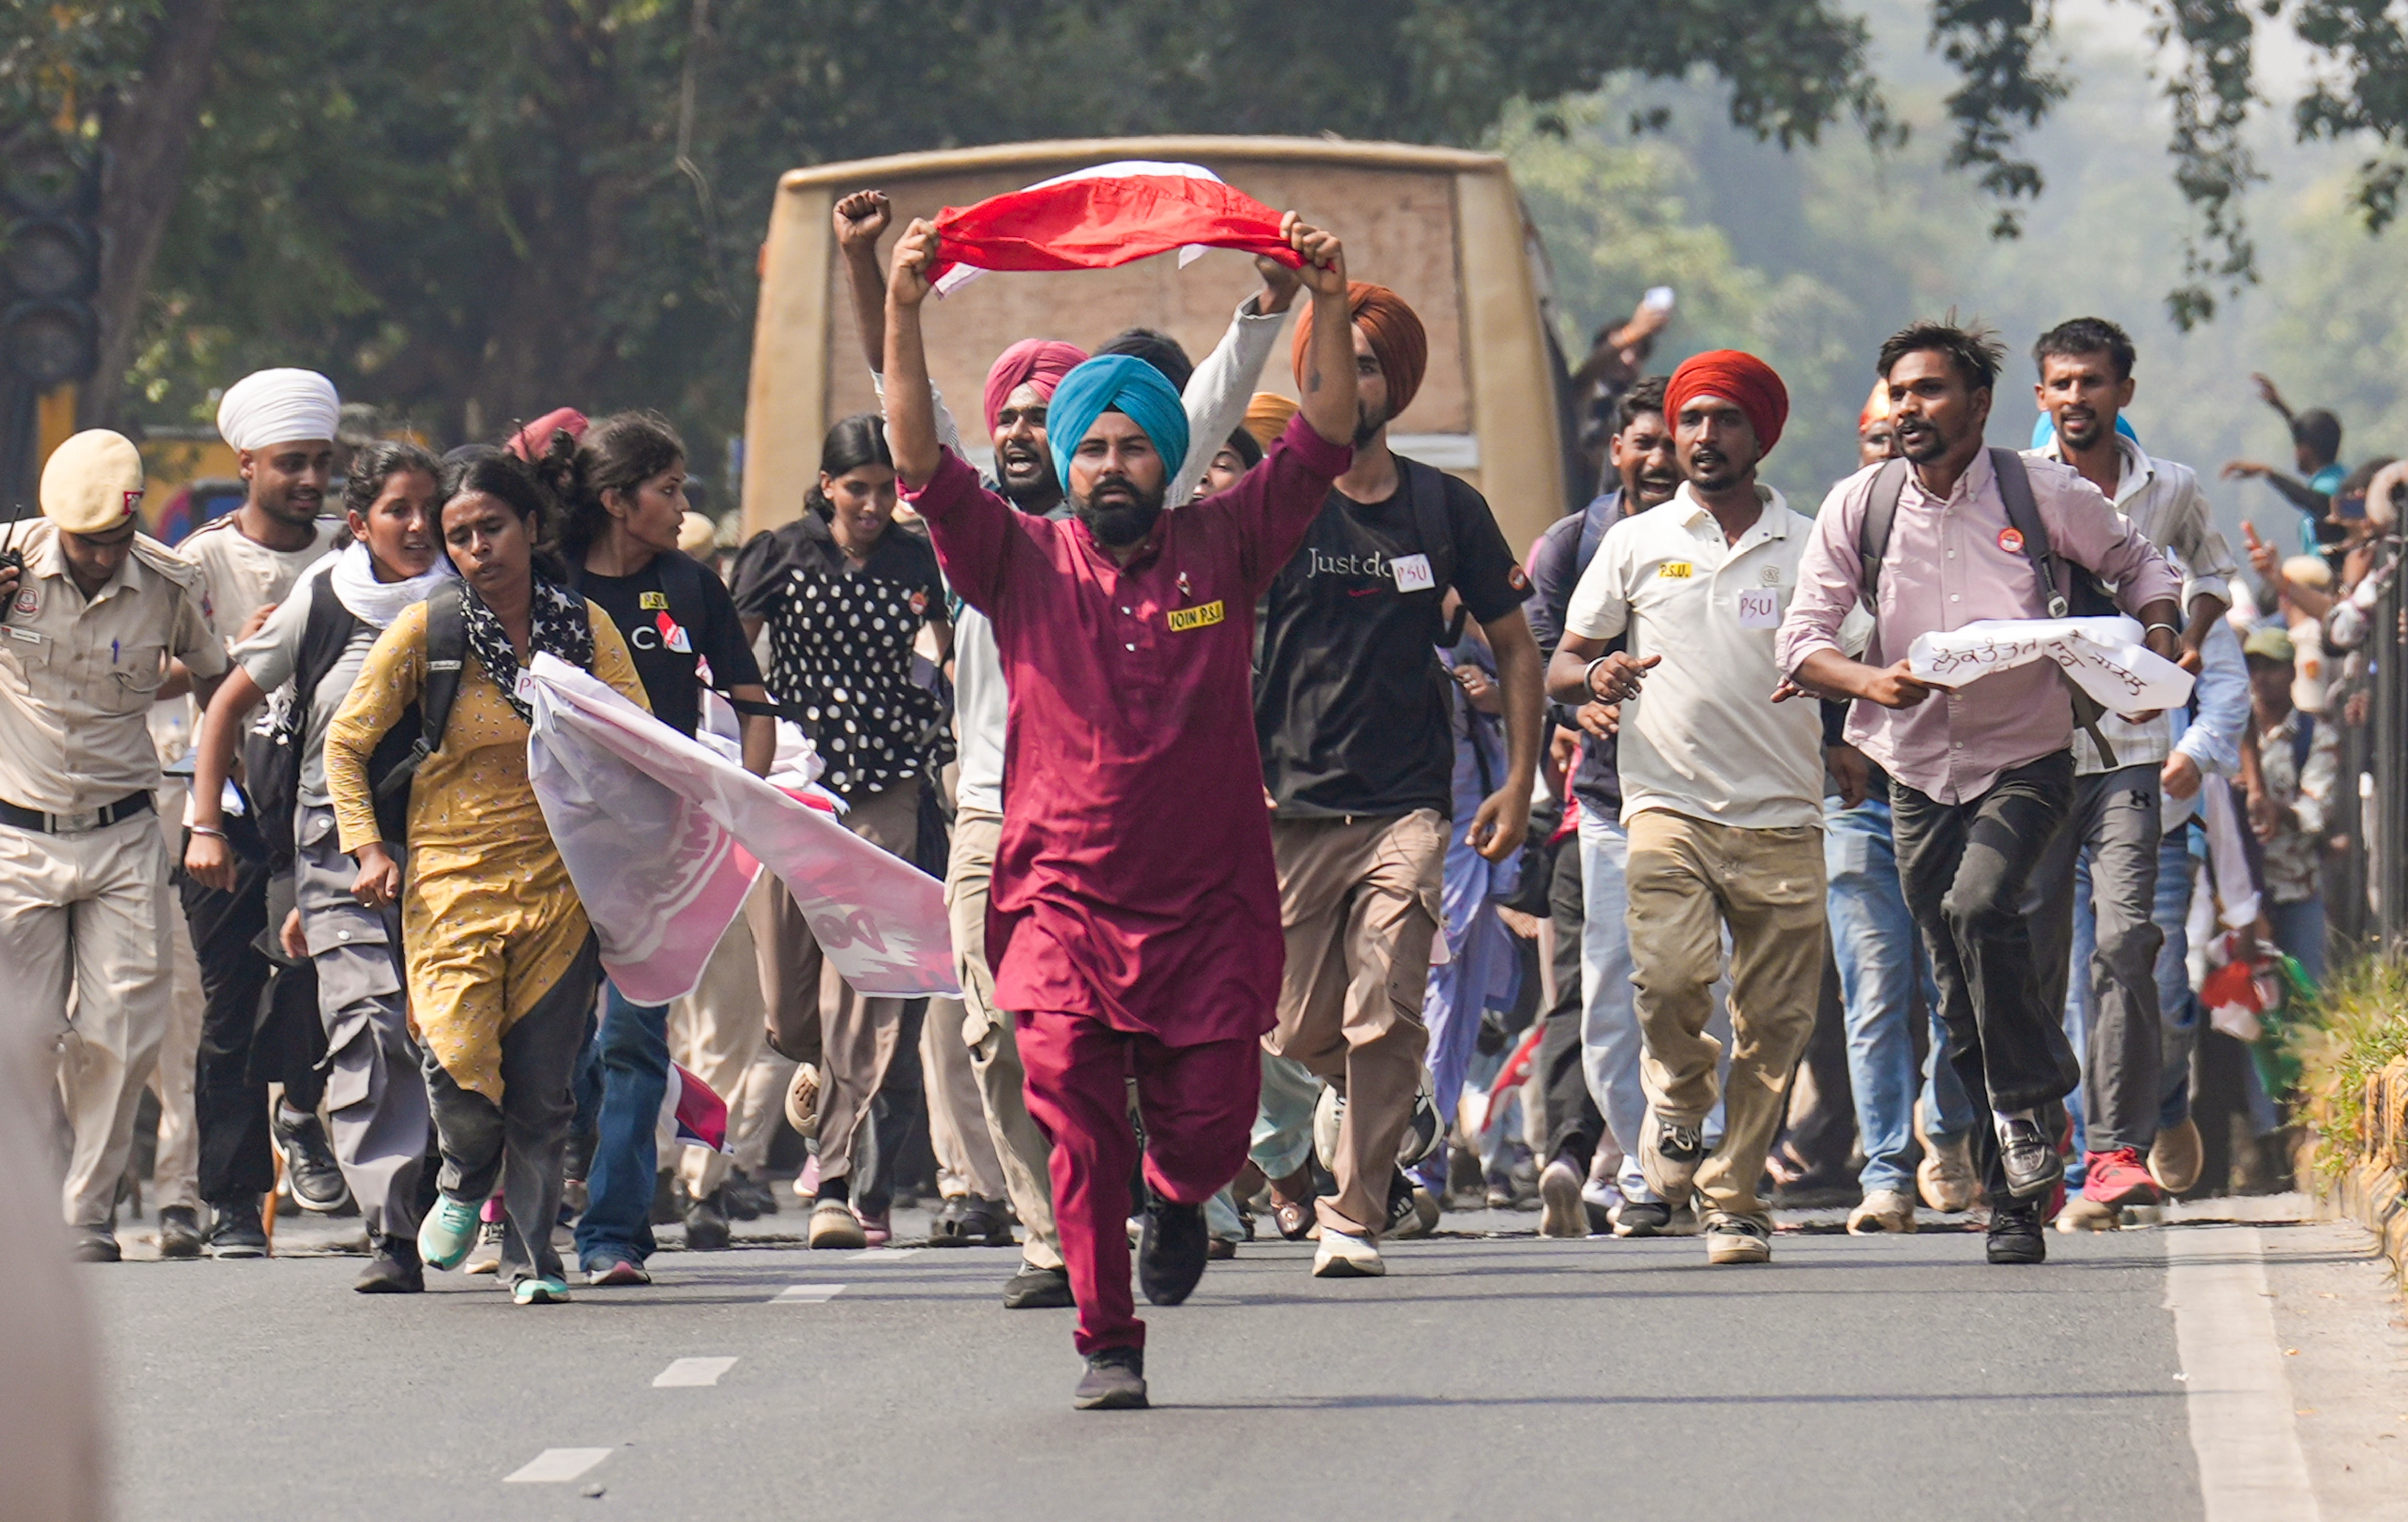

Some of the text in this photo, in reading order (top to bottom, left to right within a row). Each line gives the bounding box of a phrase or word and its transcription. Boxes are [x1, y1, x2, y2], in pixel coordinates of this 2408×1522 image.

[1306, 547, 1360, 578] Just
[1397, 564, 1427, 584] PSU
[1740, 597, 1772, 619] PSU
[1170, 610, 1197, 629] JOIN
